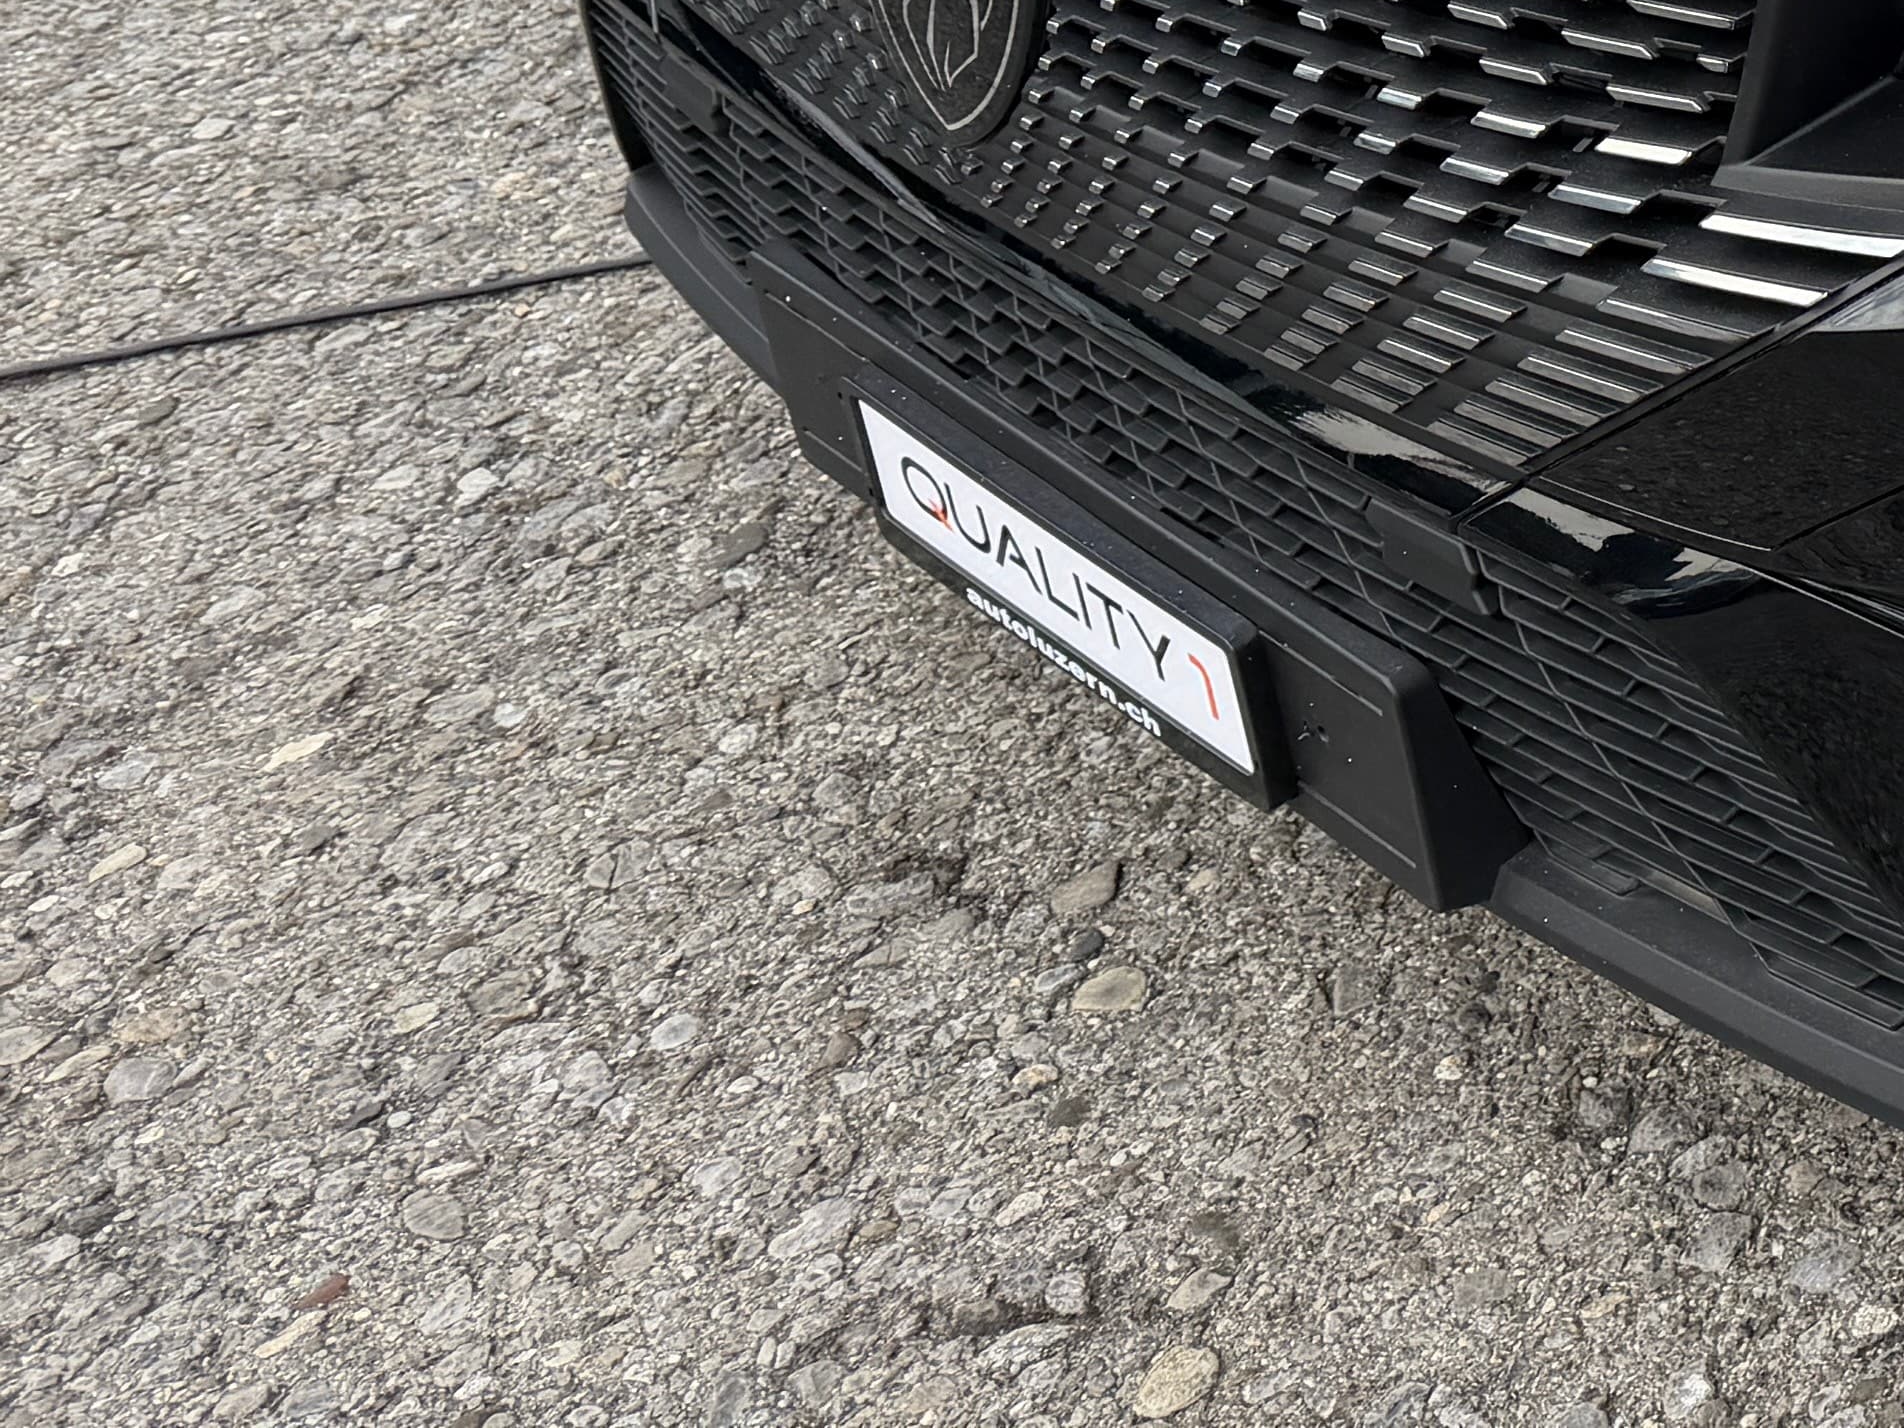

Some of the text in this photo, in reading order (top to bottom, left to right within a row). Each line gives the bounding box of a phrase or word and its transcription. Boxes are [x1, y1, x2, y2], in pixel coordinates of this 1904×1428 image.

[900, 455, 1221, 721] QUALITY 1
[965, 586, 1163, 738] autoluzern.ch
